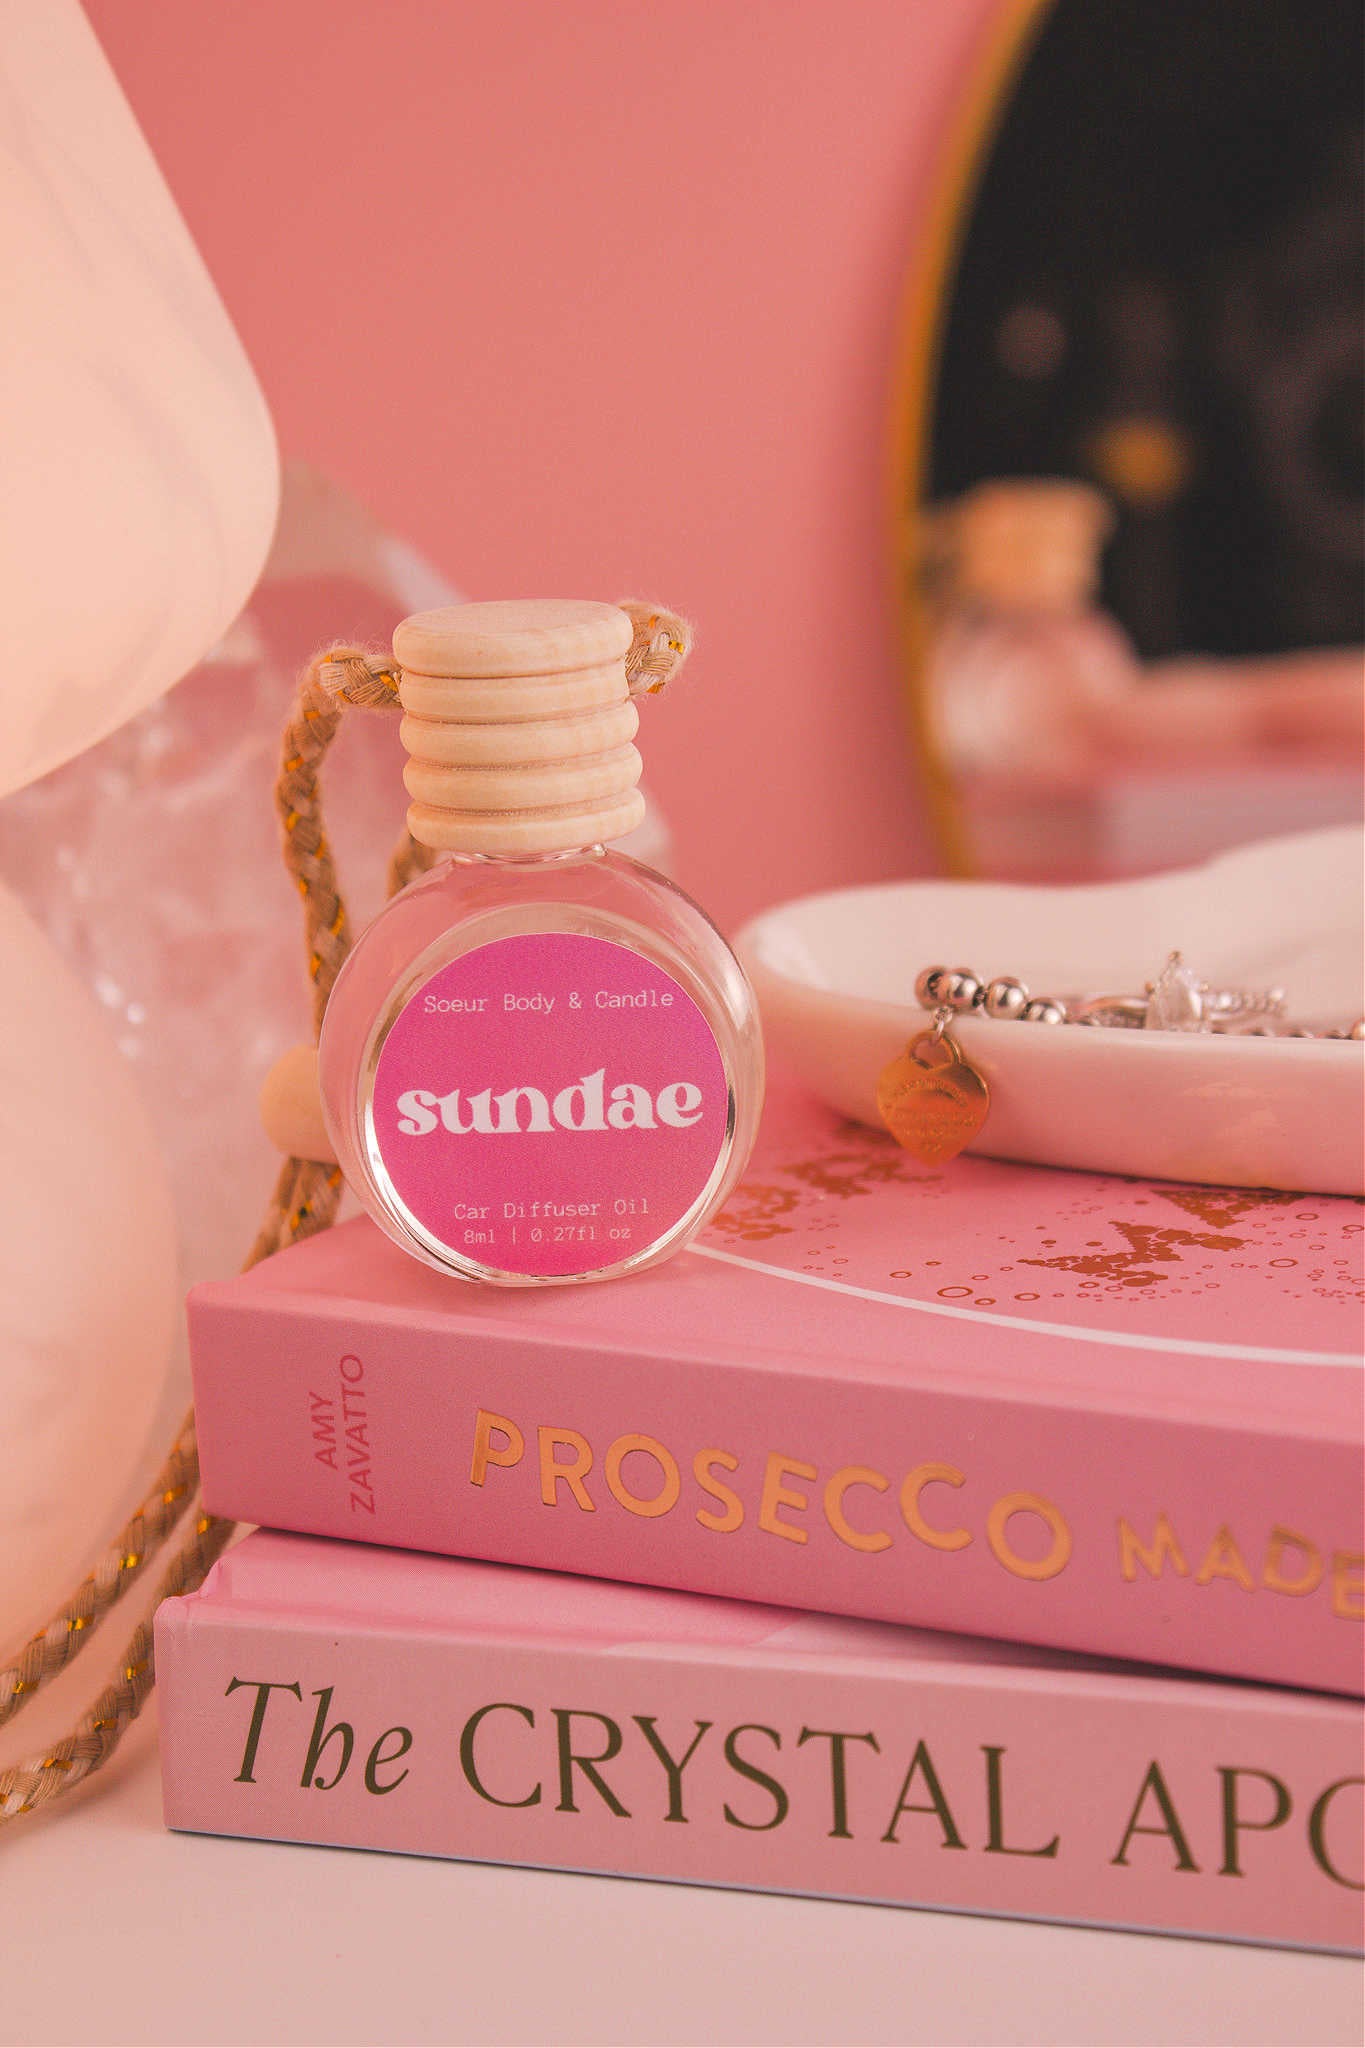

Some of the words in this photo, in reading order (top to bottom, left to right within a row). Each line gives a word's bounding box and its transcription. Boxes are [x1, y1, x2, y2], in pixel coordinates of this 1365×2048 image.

[423, 995, 488, 1014] Soeur
[503, 993, 555, 1014] Body
[569, 992, 582, 1009] &
[594, 990, 674, 1008] Candle
[396, 1068, 704, 1136] sundae
[453, 1204, 489, 1220] Car
[503, 1201, 600, 1218] Diffuser
[614, 1199, 650, 1215] Oil
[463, 1228, 496, 1244] 8ml
[530, 1225, 597, 1242] 0.27fl
[609, 1228, 632, 1240] oz
[308, 1391, 339, 1471] AMY
[339, 1354, 376, 1516] ZAVATTO
[470, 1408, 1074, 1582] PROSECCO
[1116, 1510, 1364, 1622] MADE
[224, 1675, 414, 1796] The
[458, 1702, 1061, 1860] CRYSTAL
